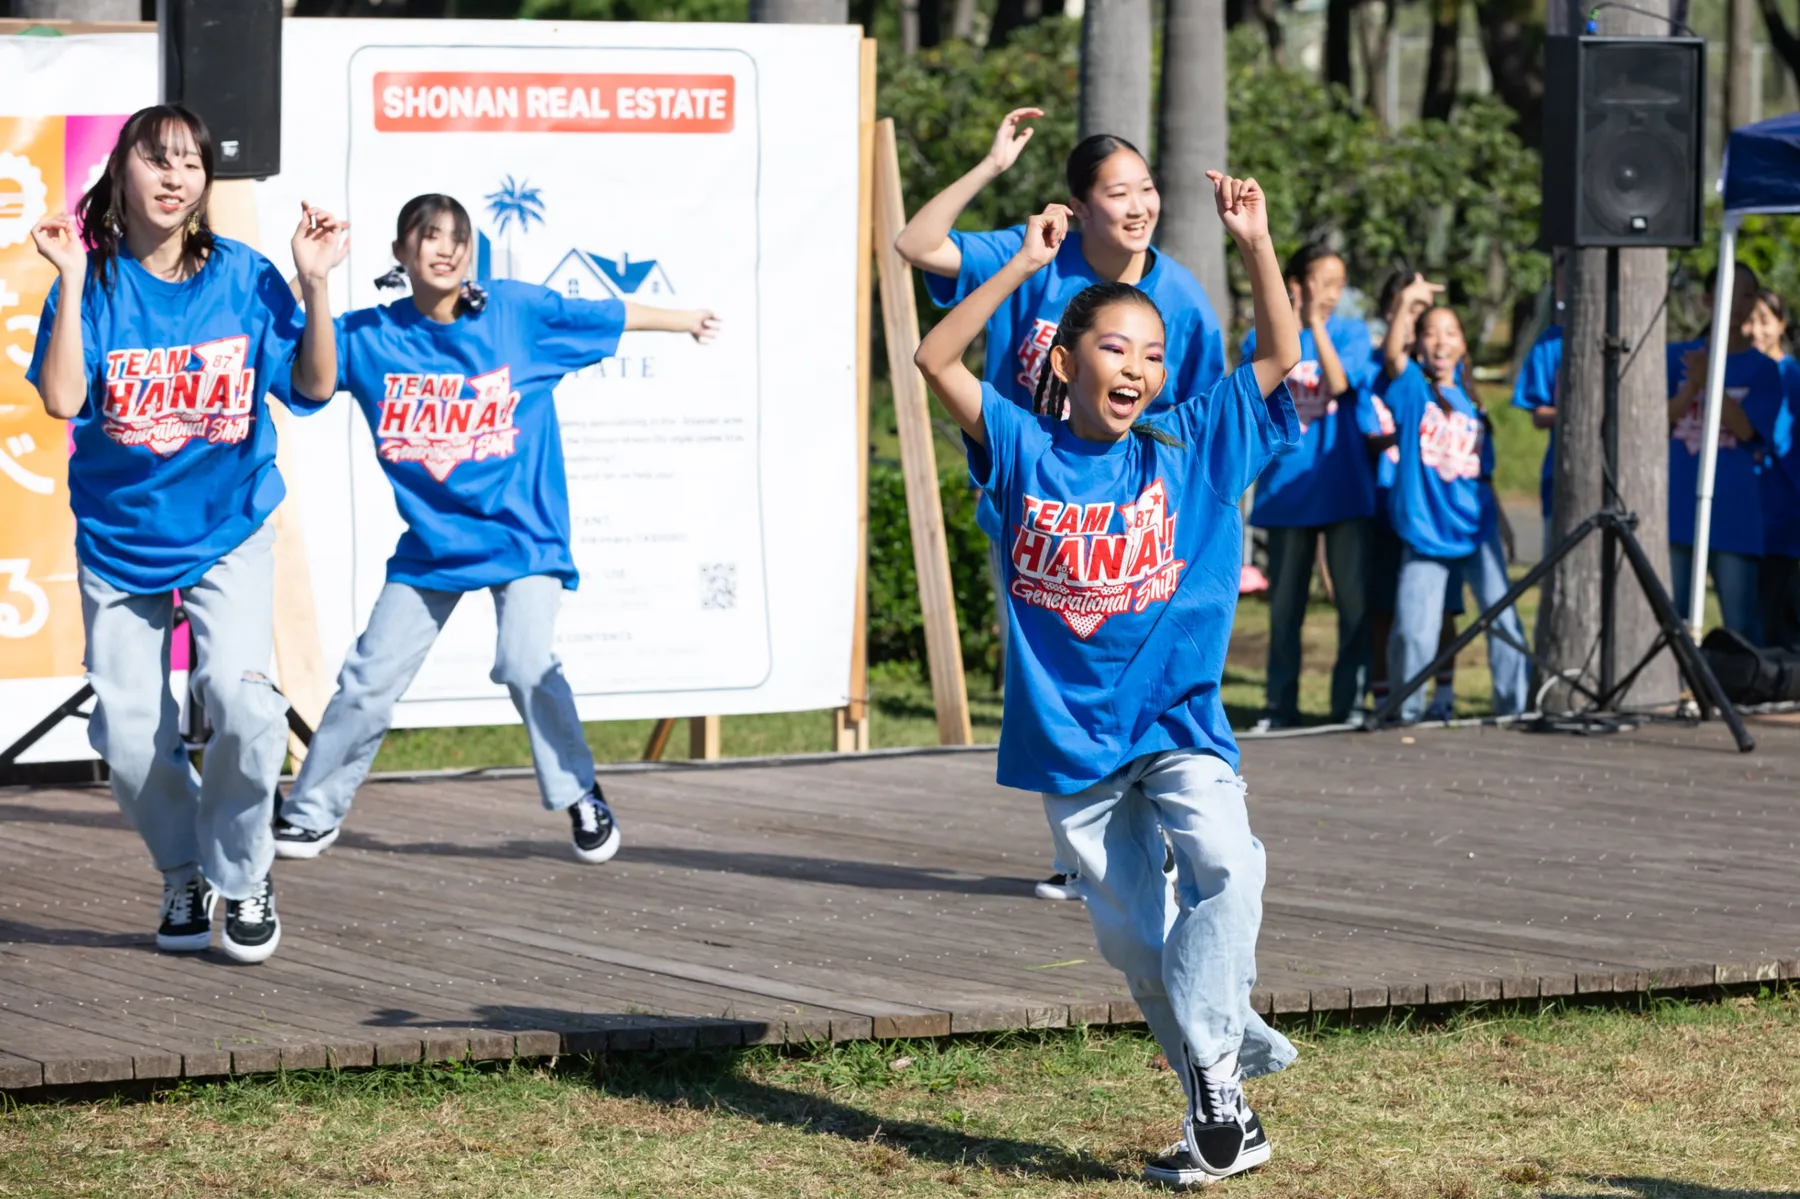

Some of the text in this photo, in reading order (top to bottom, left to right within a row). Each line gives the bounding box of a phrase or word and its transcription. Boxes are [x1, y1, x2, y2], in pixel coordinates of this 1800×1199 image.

[383, 85, 728, 120] SHONAN REAL ESTATE
[107, 346, 190, 379] TEAM
[212, 354, 233, 369] 87
[574, 356, 656, 379] ATE
[104, 369, 254, 420] HANA!
[384, 373, 464, 399] TEAM
[379, 394, 519, 437] HANA!
[1022, 493, 1115, 535] TEAM
[1135, 508, 1154, 529] 87
[1012, 513, 1177, 585] HANA!
[1011, 576, 1132, 614] Generational
